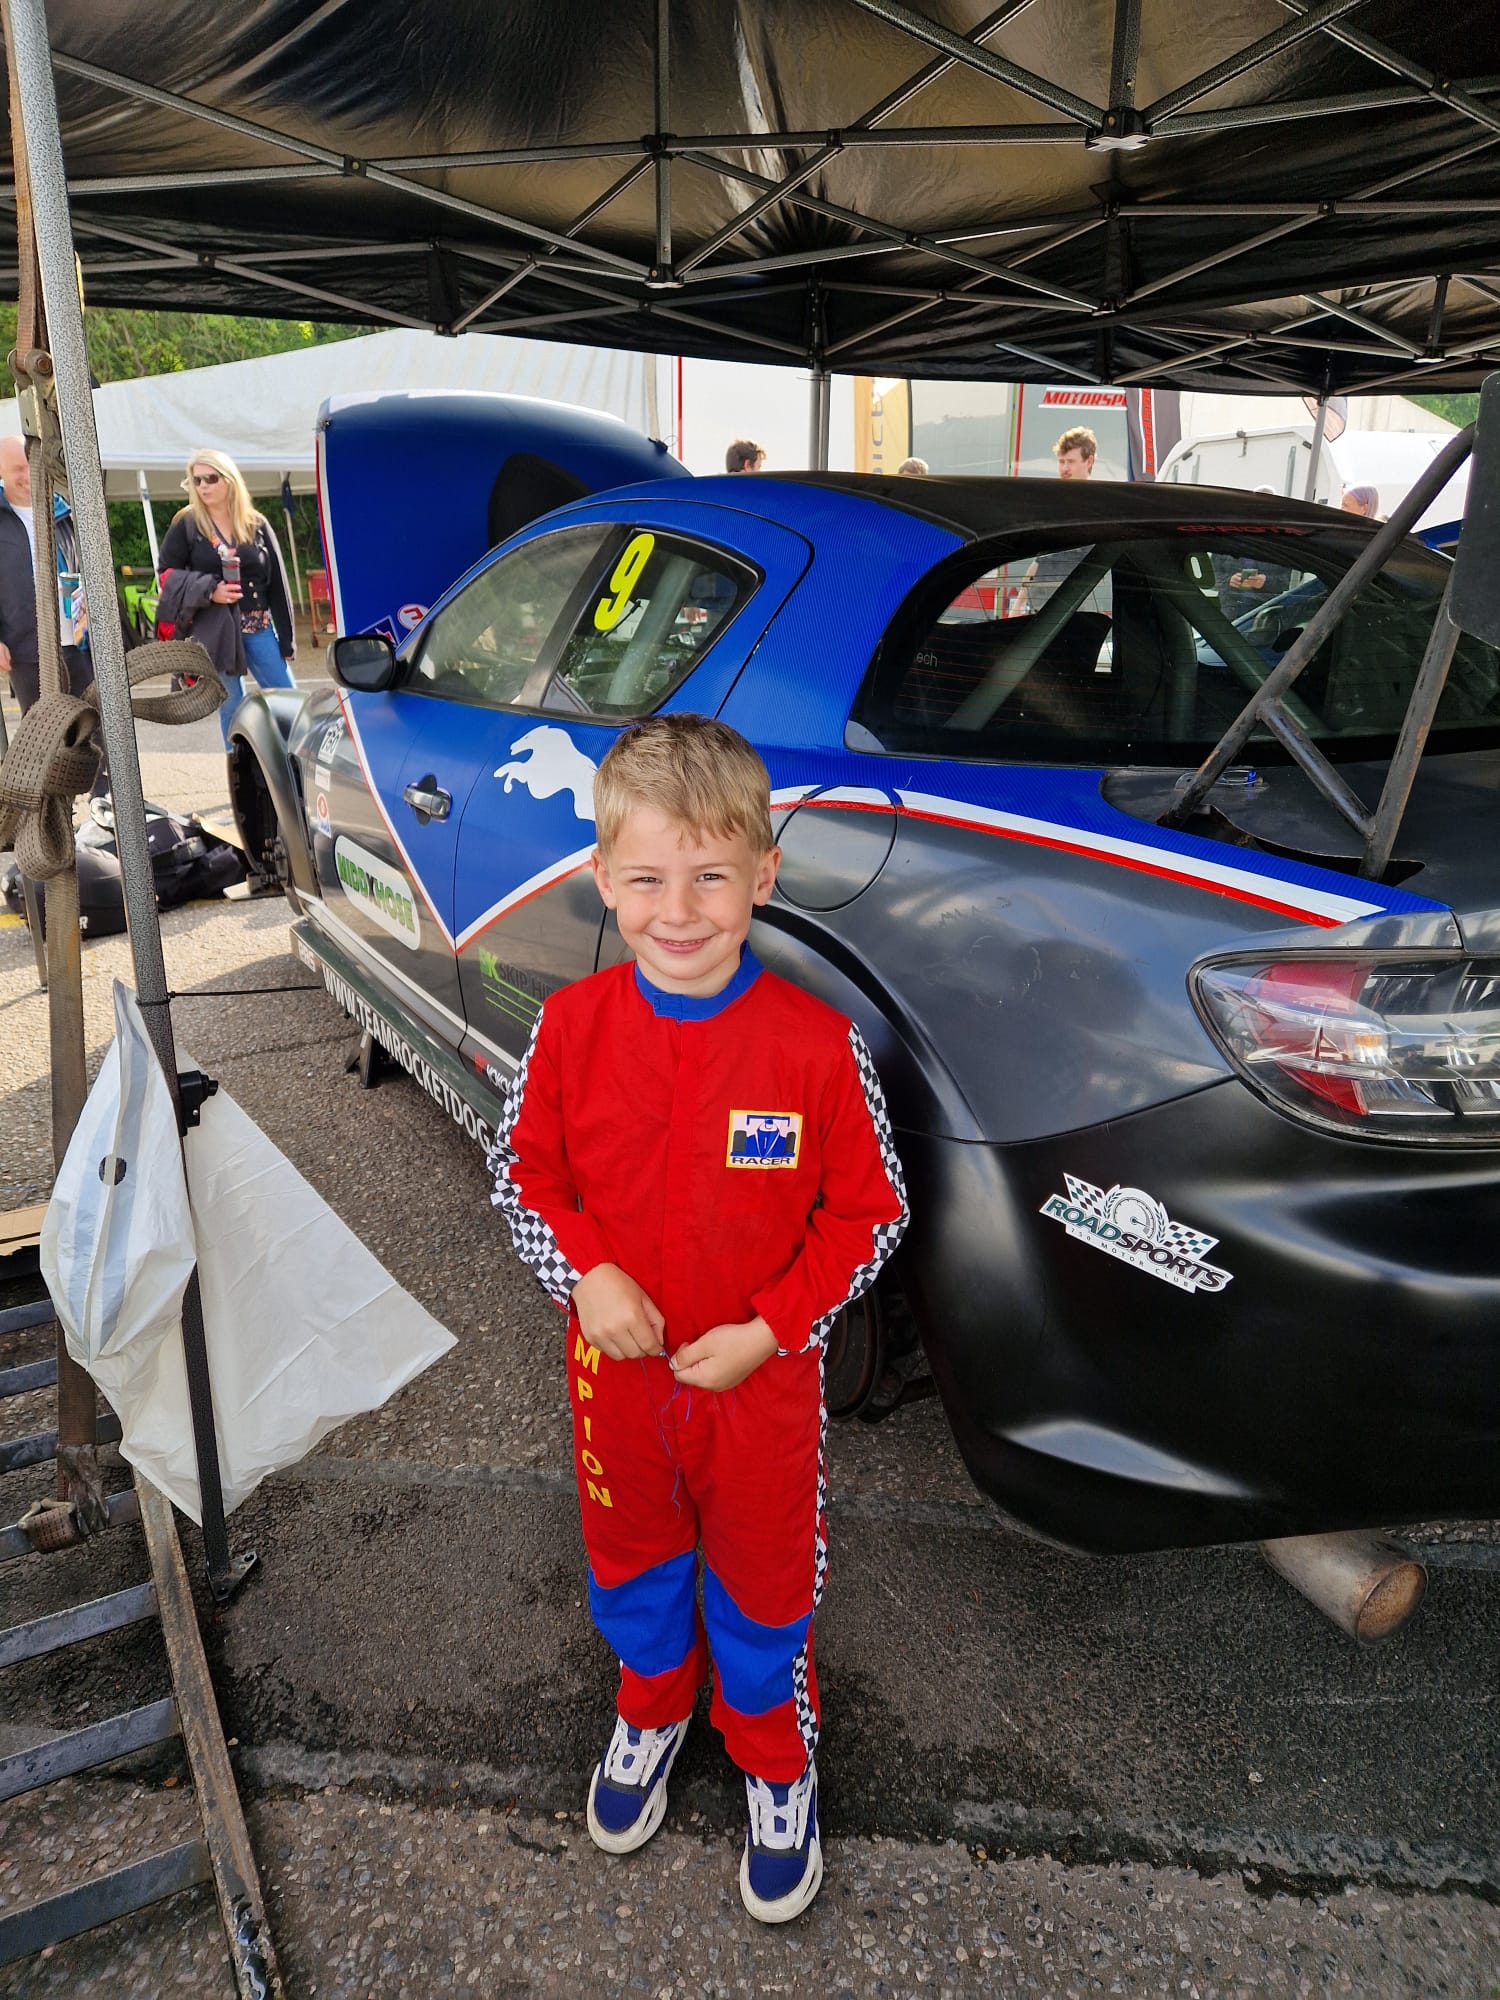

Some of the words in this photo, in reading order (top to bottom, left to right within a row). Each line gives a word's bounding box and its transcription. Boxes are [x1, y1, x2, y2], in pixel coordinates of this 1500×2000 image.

[593, 533, 655, 632] 9
[500, 962, 528, 989] SKIP
[731, 1157, 791, 1166] RACER
[1046, 1199, 1225, 1288] ROADSPORTS
[1071, 1227, 1091, 1241] 750
[1101, 1241, 1144, 1266] MOTOR
